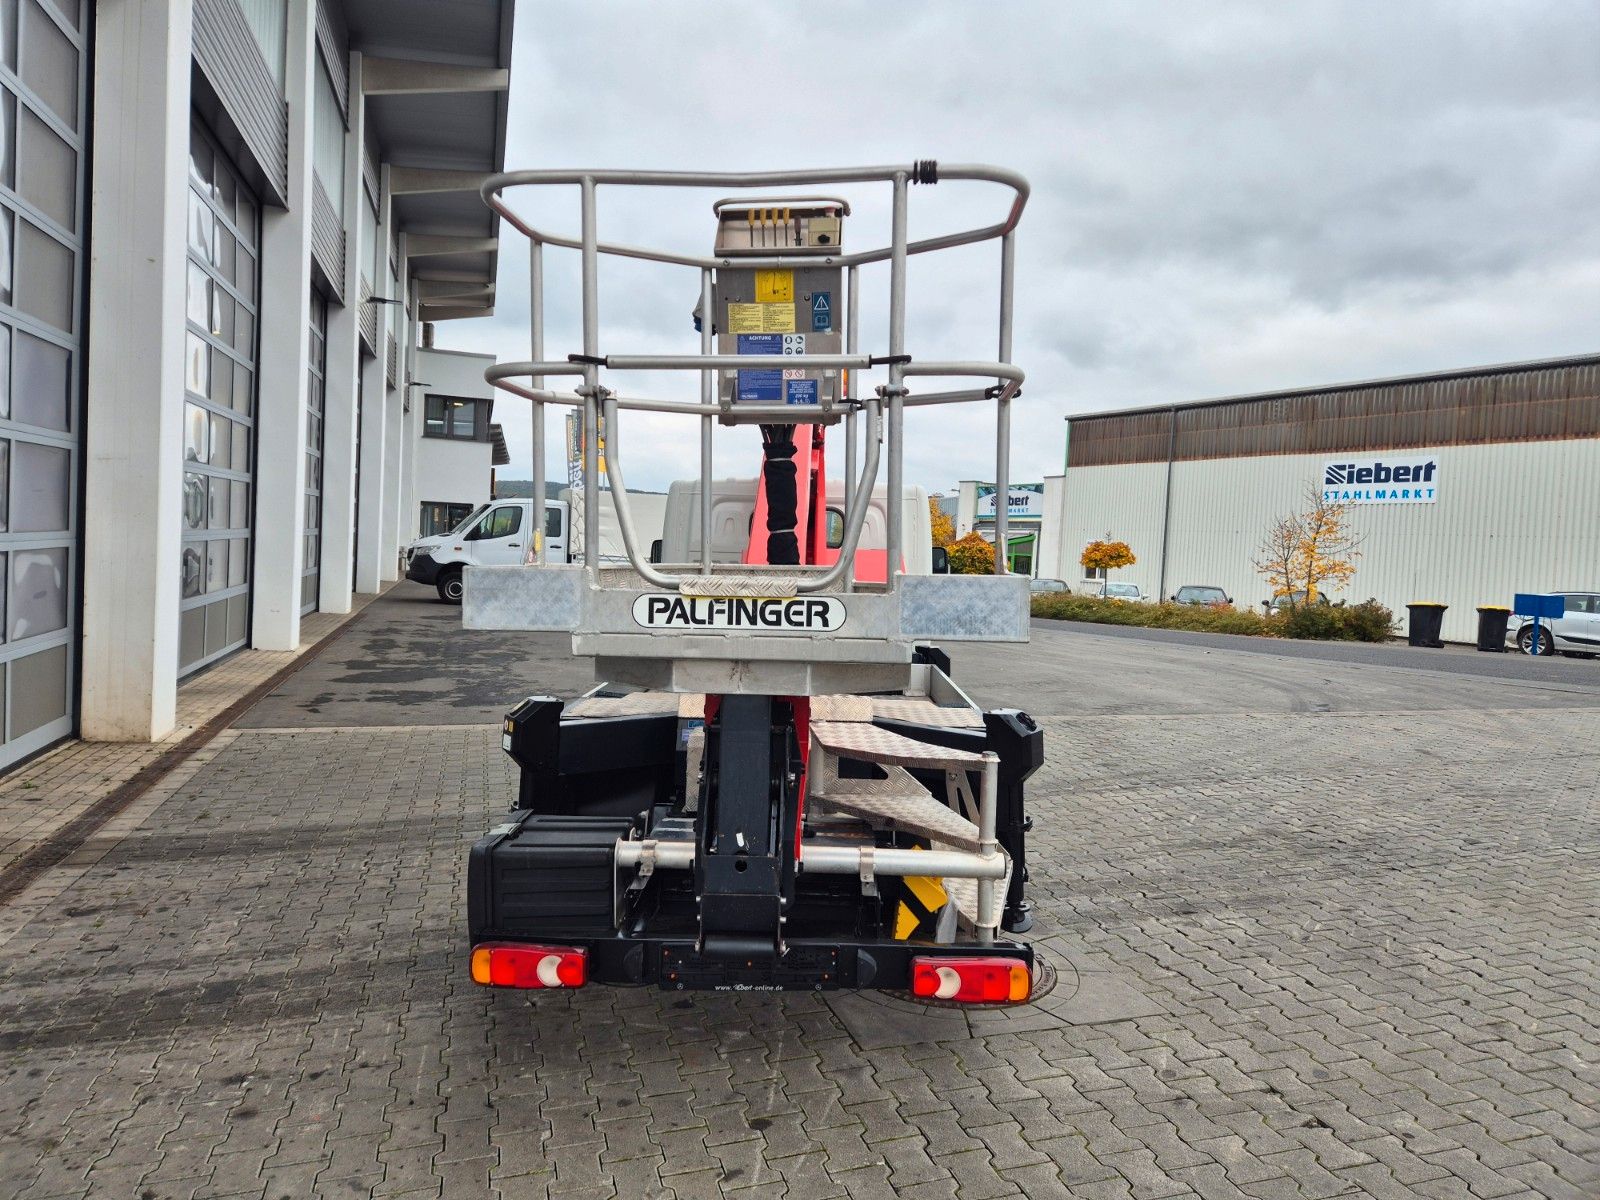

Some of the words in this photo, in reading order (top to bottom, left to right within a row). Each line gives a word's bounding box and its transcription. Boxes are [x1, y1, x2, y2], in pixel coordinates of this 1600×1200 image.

[1325, 460, 1437, 485] Siebert
[990, 495, 1029, 506] Sbert
[1324, 488, 1435, 500] STAHLMARKT
[648, 598, 830, 627] PALFINGER
